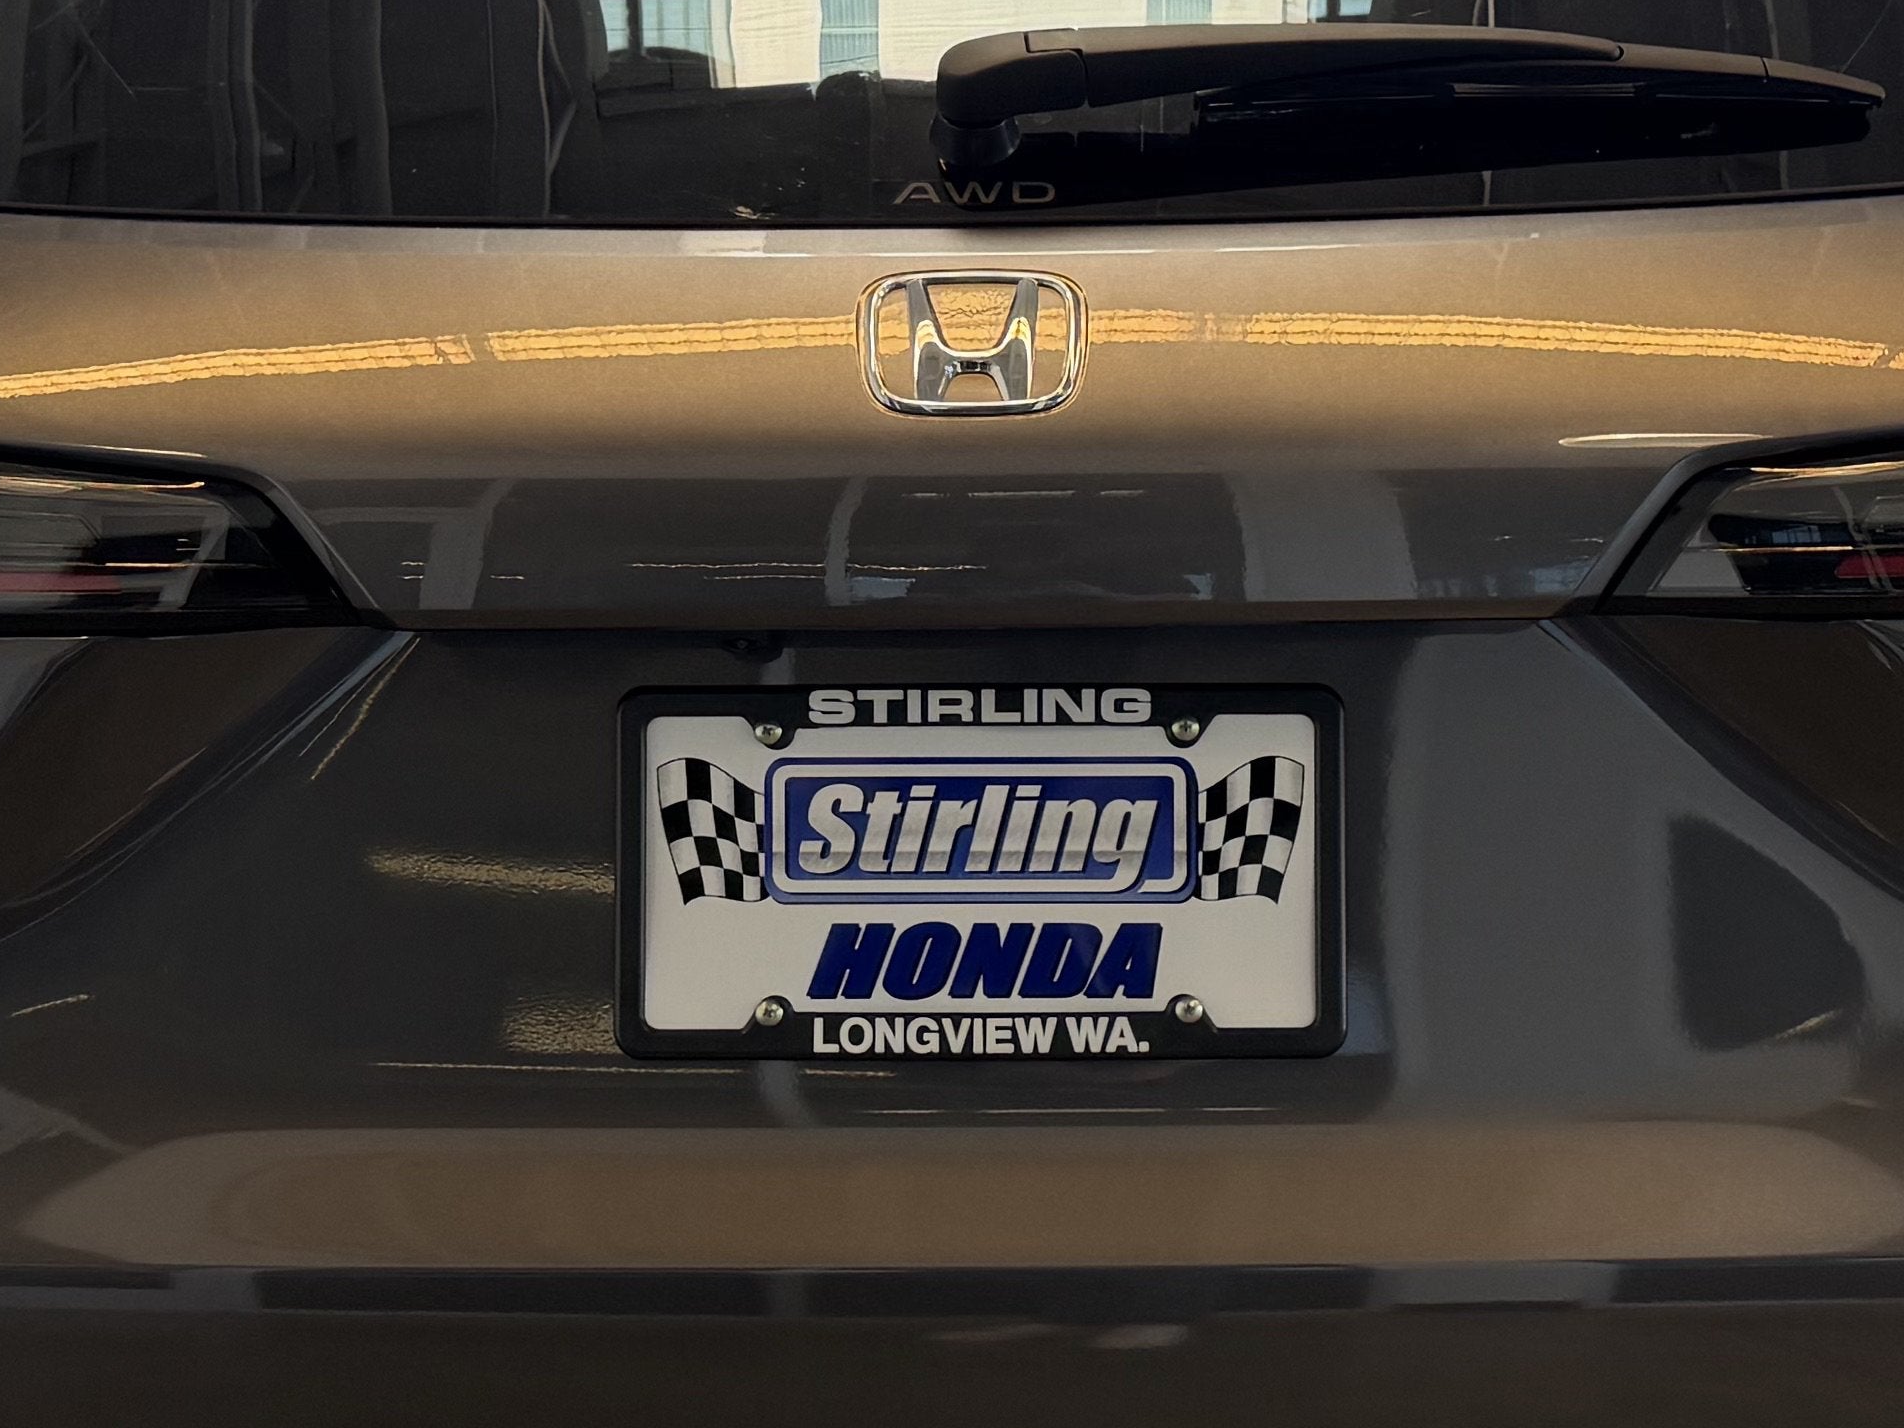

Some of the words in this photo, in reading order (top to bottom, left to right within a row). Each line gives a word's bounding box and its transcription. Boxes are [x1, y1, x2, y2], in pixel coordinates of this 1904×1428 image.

[893, 181, 1056, 205] AWD
[808, 689, 1152, 725] STIRLING
[798, 783, 1159, 890] Stirling
[807, 921, 1163, 1000] HONDA
[813, 1017, 1057, 1054] LONGVIEW
[1064, 1016, 1150, 1053] WA.
